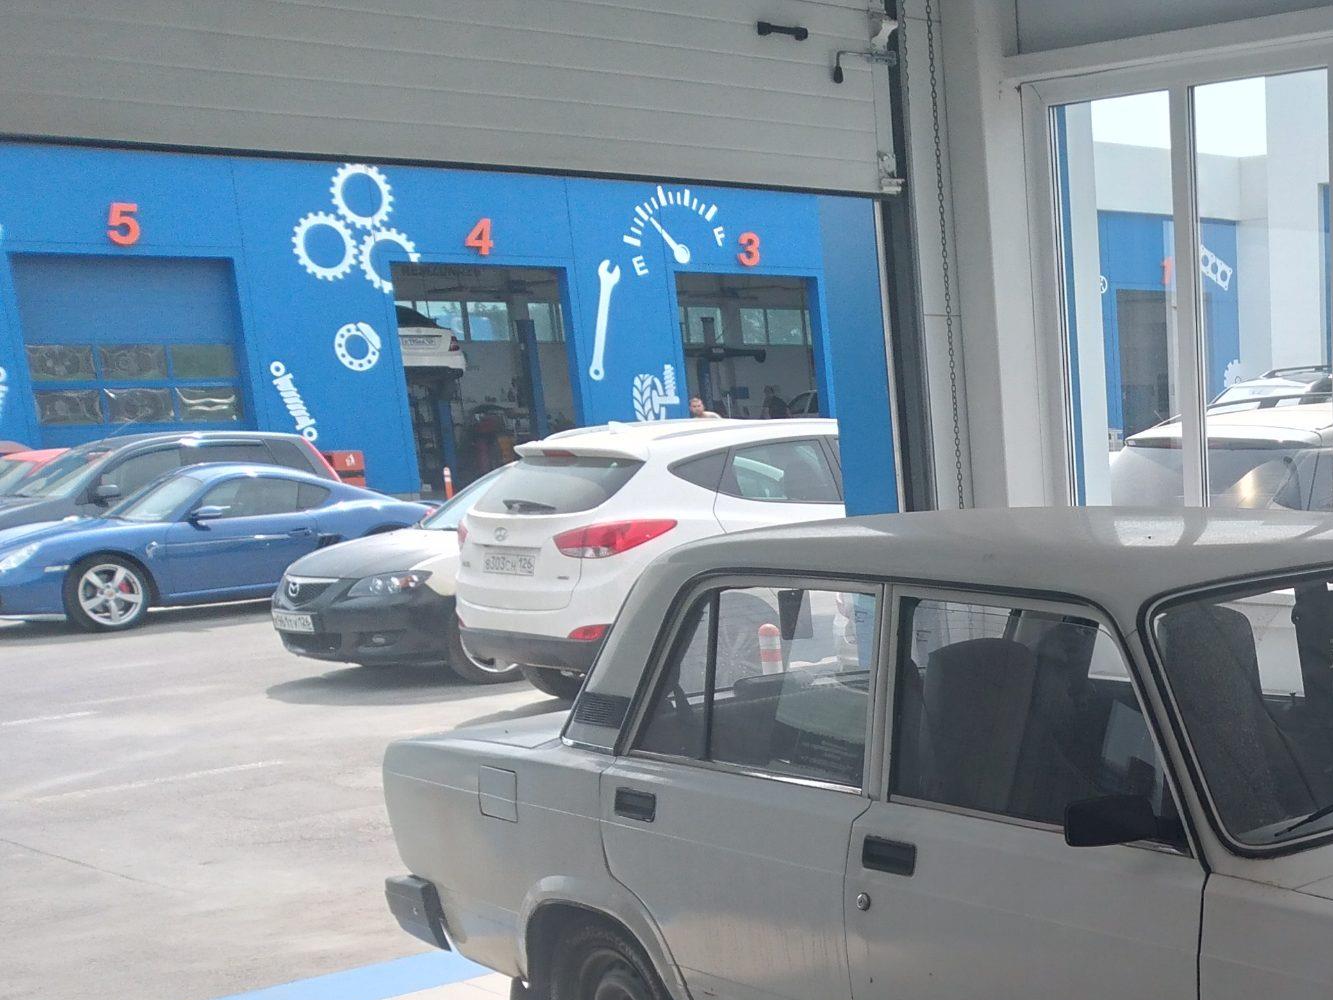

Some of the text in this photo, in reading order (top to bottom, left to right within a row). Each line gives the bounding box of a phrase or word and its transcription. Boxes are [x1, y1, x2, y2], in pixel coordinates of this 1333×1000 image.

[107, 202, 140, 245] 5
[465, 218, 494, 255] 4
[713, 226, 726, 247] F
[632, 255, 649, 277] E
[738, 231, 760, 266] 3
